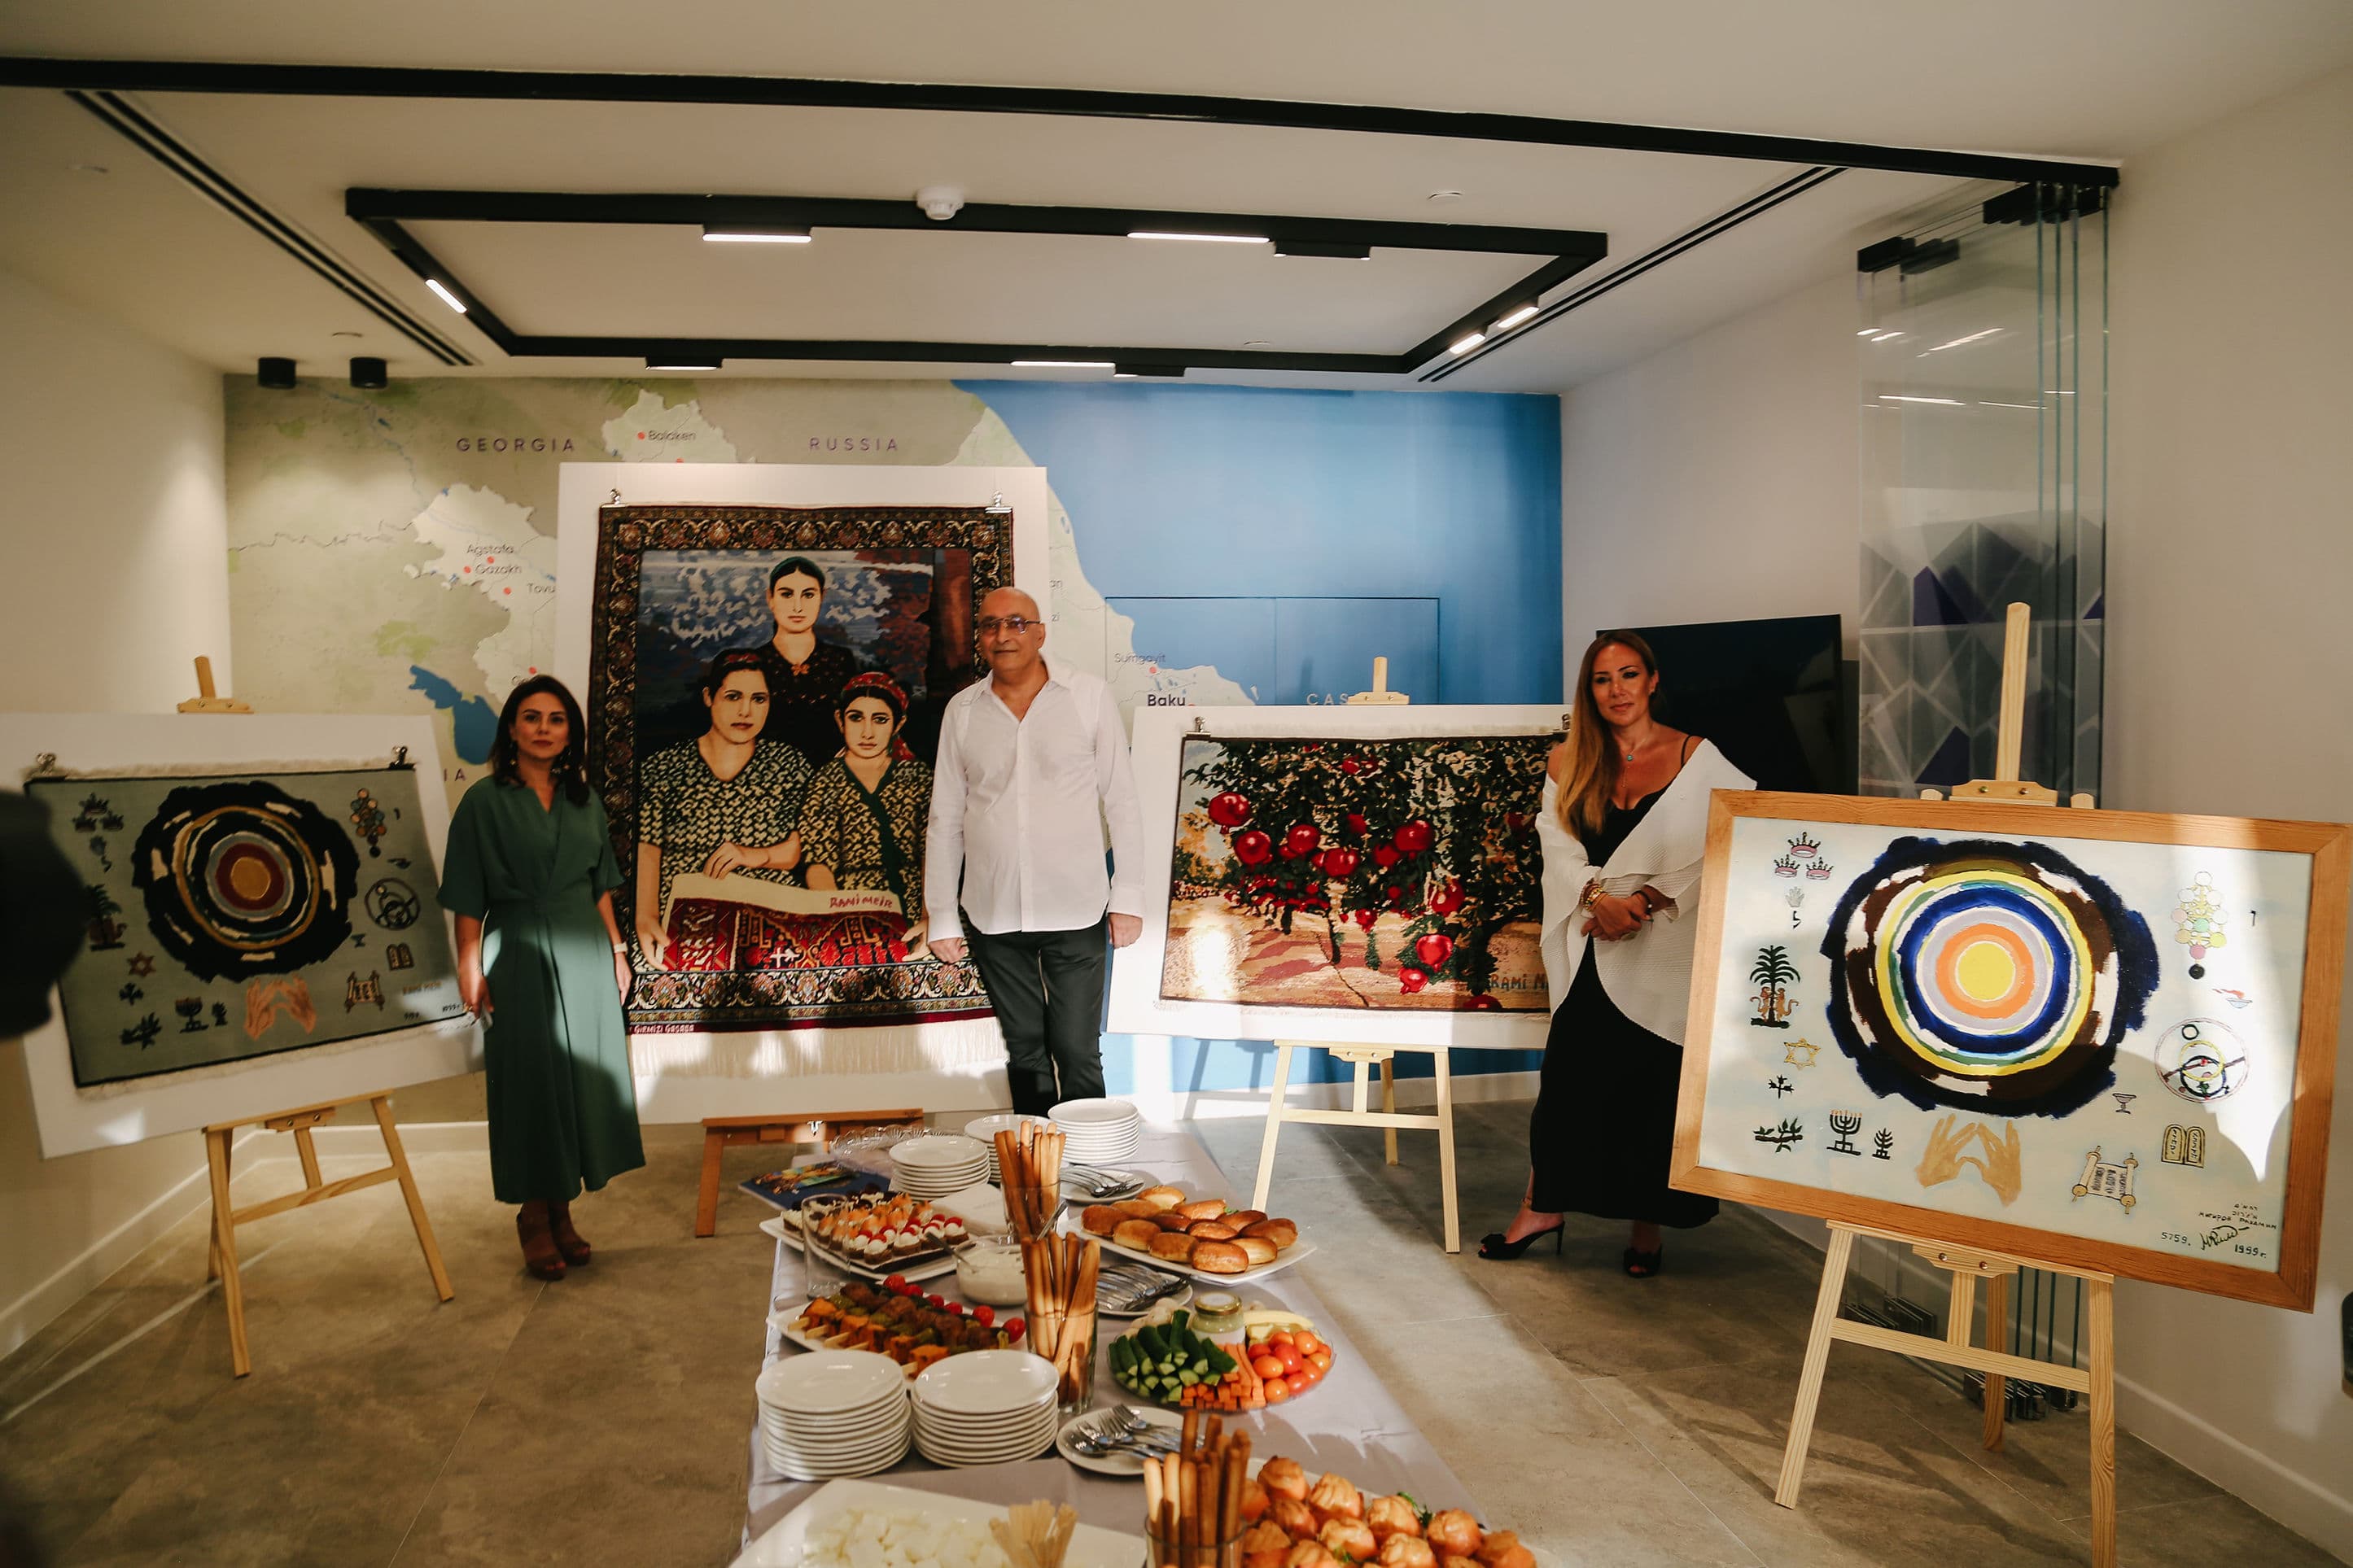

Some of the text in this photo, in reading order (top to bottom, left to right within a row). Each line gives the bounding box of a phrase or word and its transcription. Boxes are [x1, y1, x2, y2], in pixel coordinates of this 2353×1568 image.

[456, 437, 575, 452] GEORGIA
[810, 437, 898, 451] RUSSIA
[1147, 694, 1186, 706] Baku
